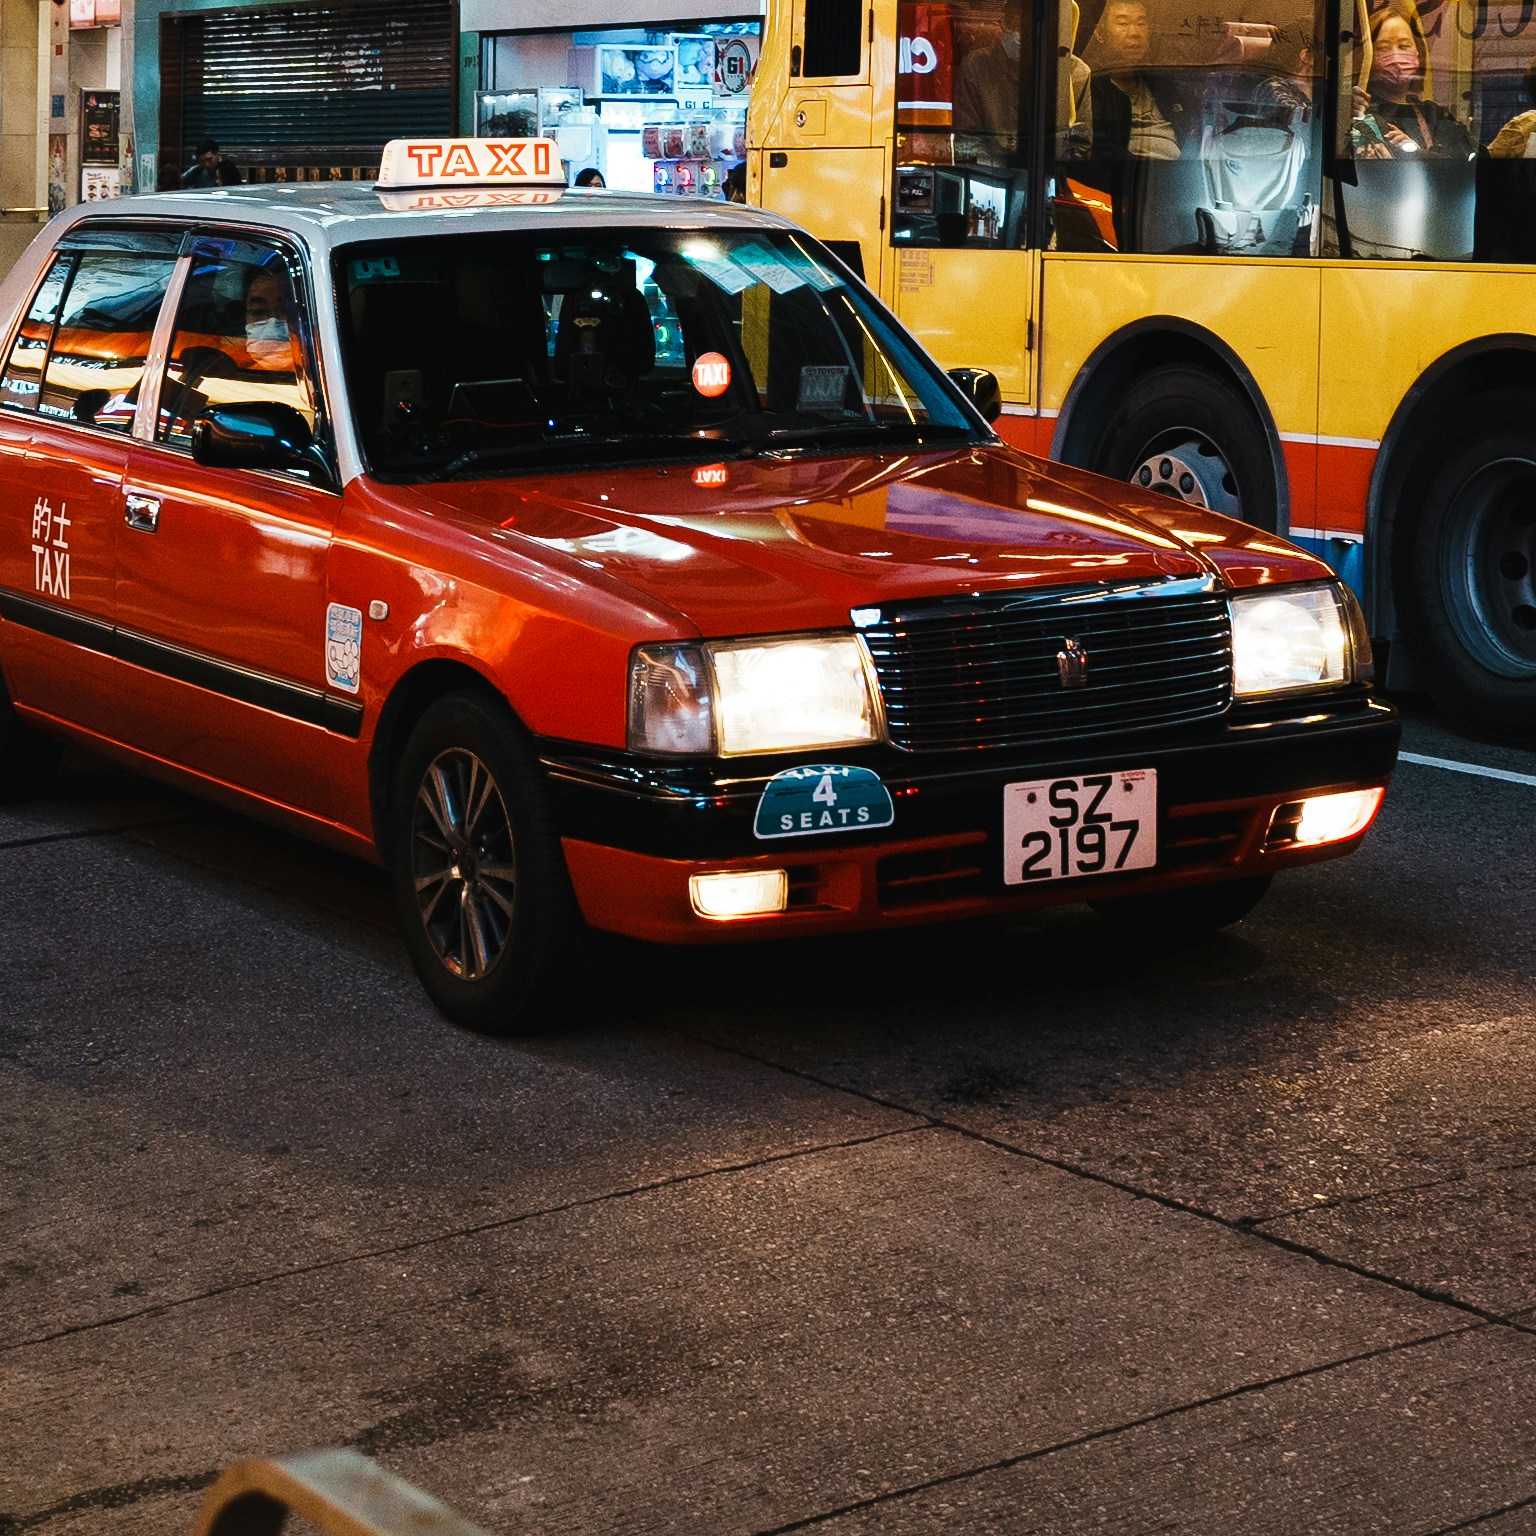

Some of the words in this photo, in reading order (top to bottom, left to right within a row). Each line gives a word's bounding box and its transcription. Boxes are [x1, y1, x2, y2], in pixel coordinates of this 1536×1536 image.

[408, 143, 550, 177] TAXI
[696, 363, 728, 386] TAXI
[31, 496, 71, 550] 的士
[31, 545, 71, 600] TAXI
[785, 766, 850, 780] TAXI
[812, 775, 837, 807] 4
[1048, 775, 1113, 829] SZ
[780, 806, 870, 830] SEATS
[1021, 819, 1140, 881] 2197
